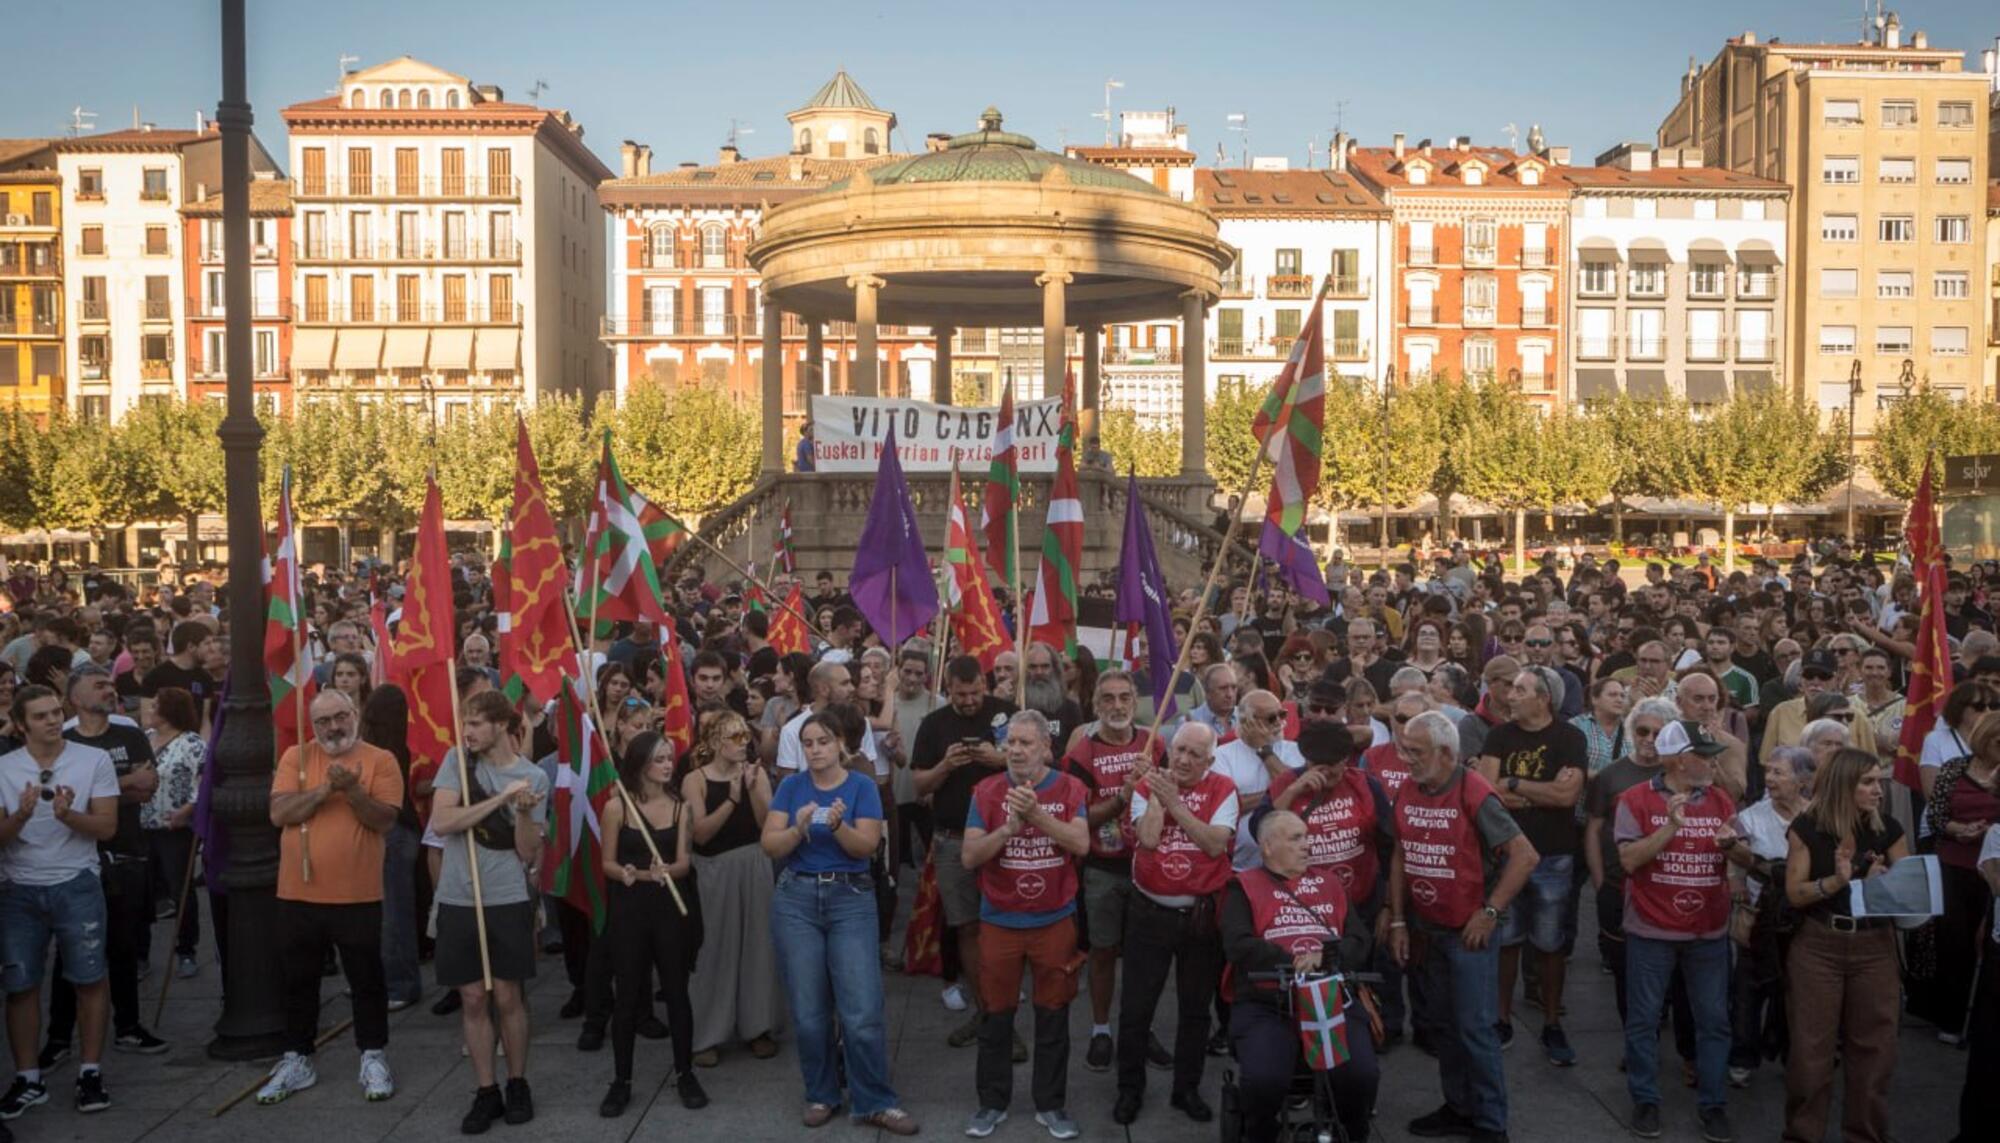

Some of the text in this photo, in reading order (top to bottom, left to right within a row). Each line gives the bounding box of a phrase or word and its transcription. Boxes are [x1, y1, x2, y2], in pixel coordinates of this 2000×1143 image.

[852, 404, 1064, 440] VITO CAGNX
[815, 440, 866, 460] Euskal
[874, 443, 939, 462] Hrrian
